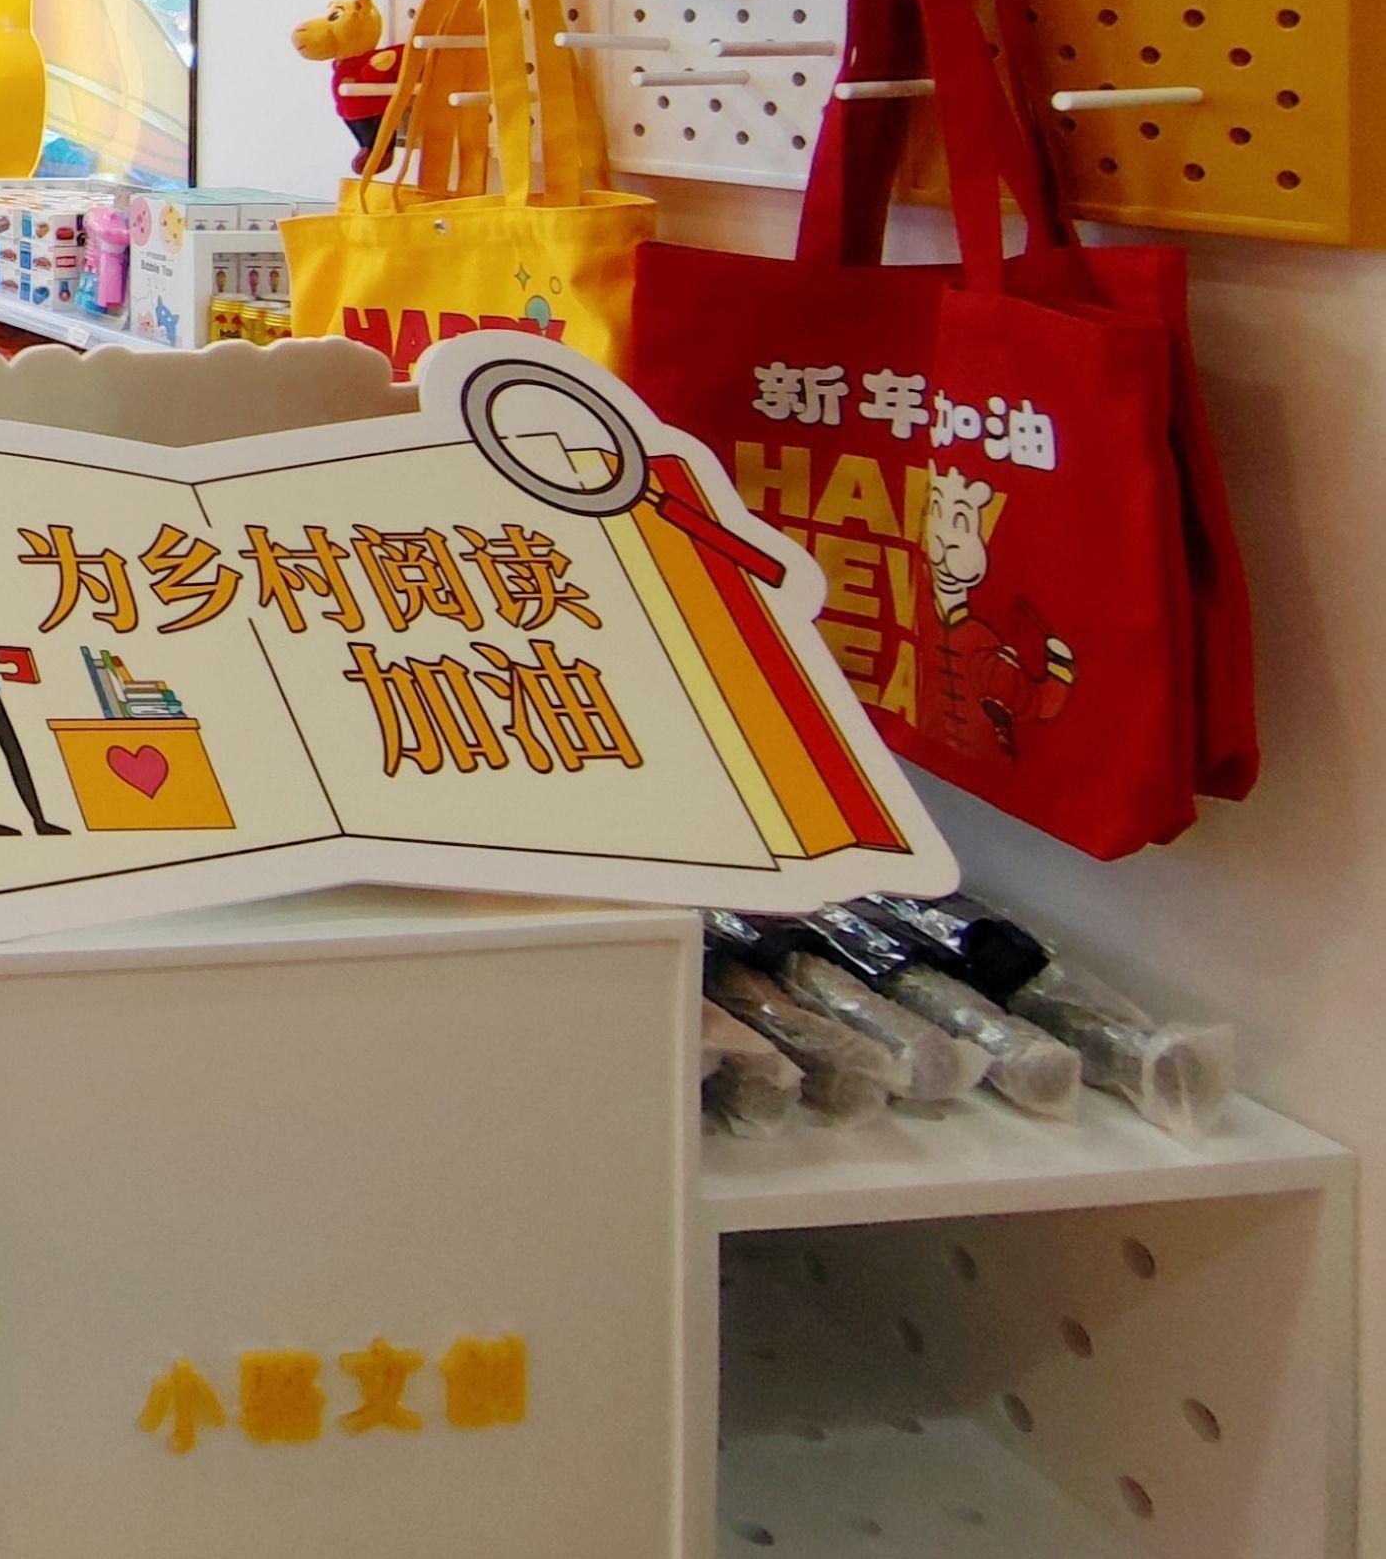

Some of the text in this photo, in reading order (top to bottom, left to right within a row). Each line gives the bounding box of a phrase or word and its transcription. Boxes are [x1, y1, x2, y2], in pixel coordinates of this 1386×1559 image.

[752, 361, 1062, 474] 新年加油
[17, 522, 604, 638] 为乡村阅读
[344, 640, 644, 775] 加油
